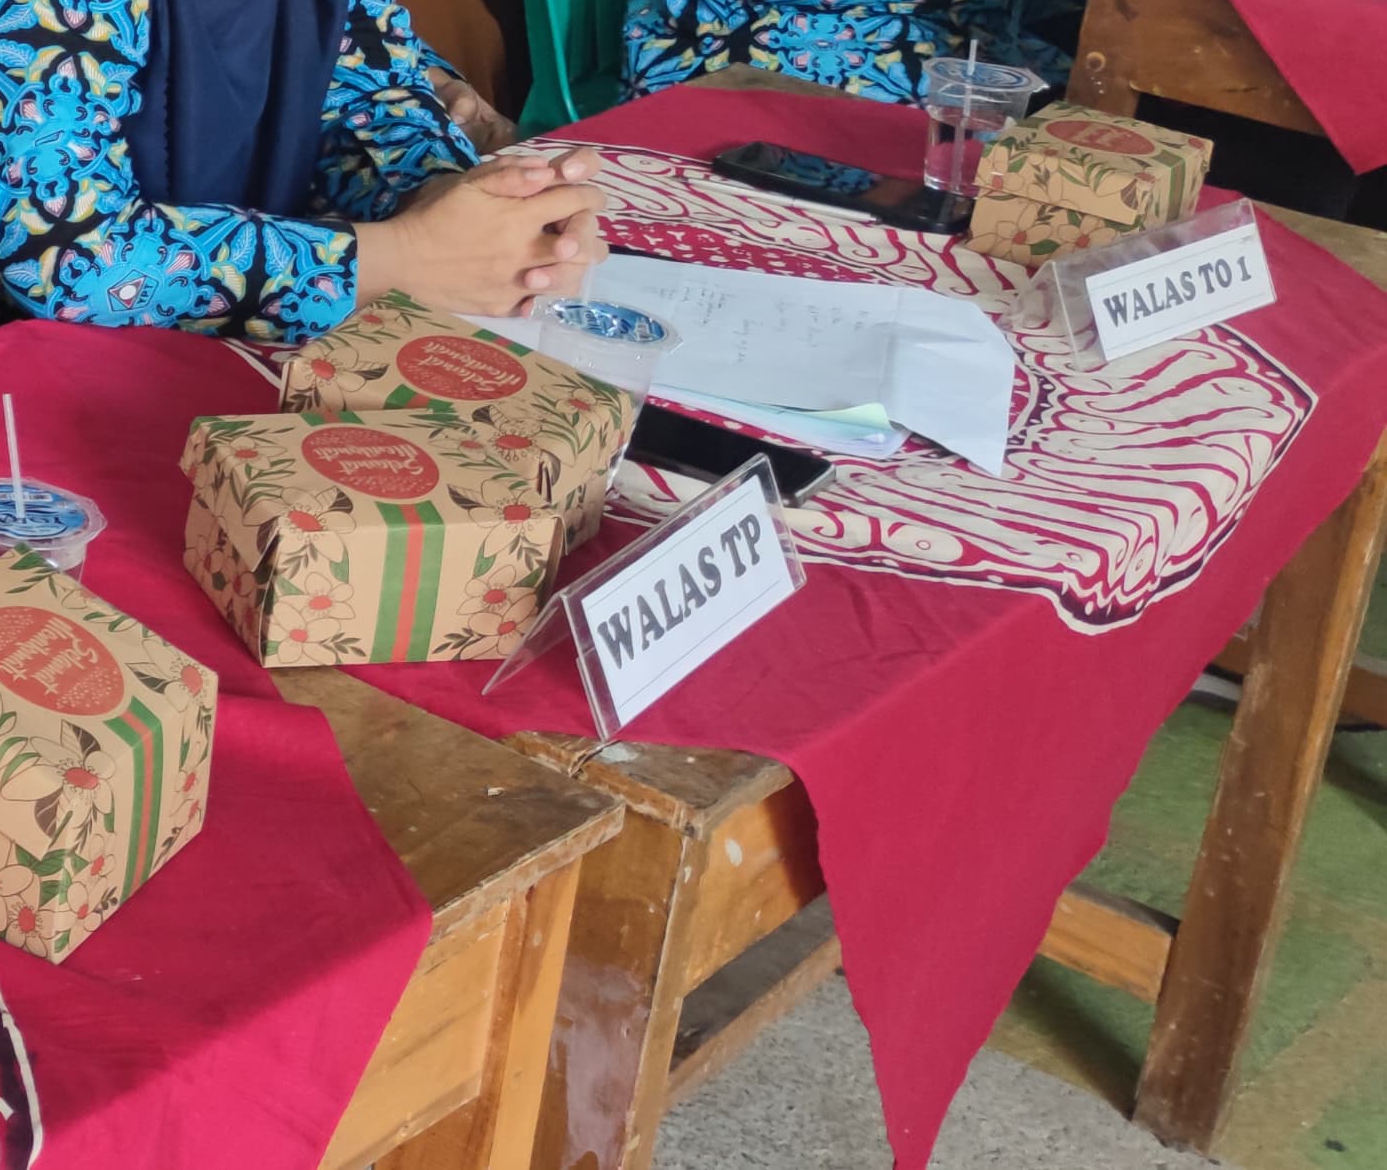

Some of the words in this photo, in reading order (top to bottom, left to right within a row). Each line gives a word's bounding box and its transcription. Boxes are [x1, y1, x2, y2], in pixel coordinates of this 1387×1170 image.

[1102, 270, 1197, 328] WALAS
[1197, 258, 1233, 295] TO
[1238, 255, 1252, 282] 1
[415, 354, 502, 392] Selamat
[317, 440, 422, 467] Menikmati
[339, 455, 423, 481] Selamat
[596, 547, 723, 670] WALAS
[721, 513, 764, 579] TP
[29, 638, 101, 696] Selamat
